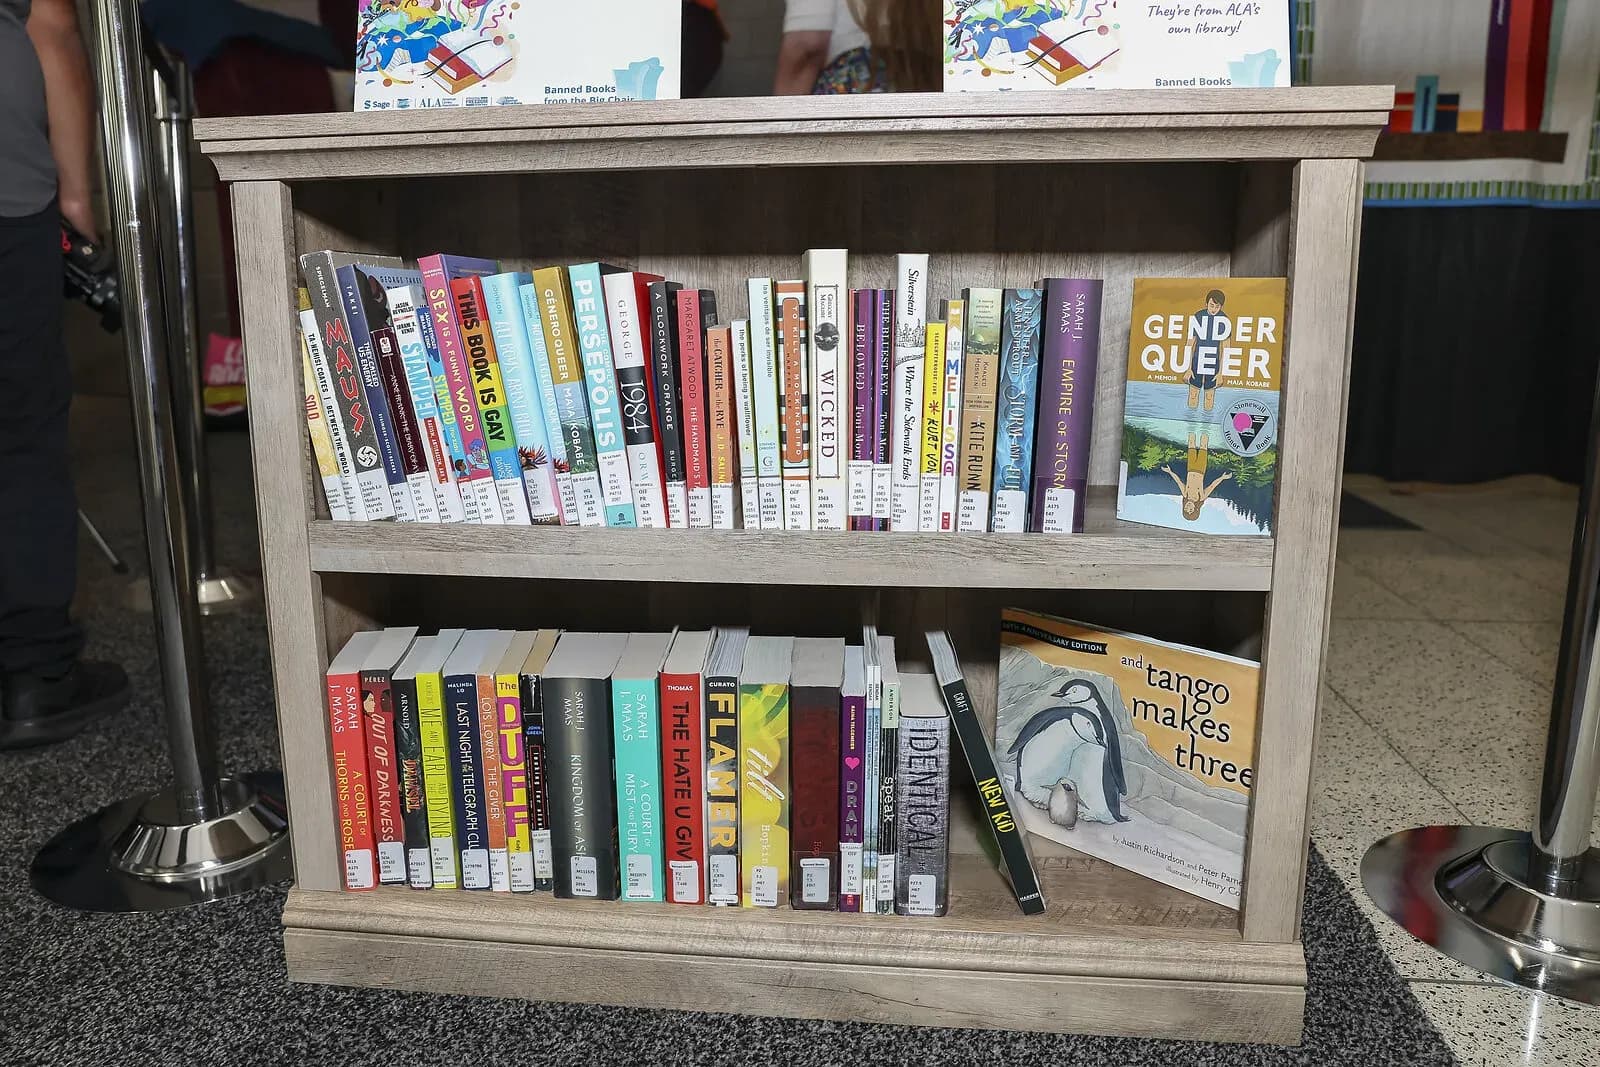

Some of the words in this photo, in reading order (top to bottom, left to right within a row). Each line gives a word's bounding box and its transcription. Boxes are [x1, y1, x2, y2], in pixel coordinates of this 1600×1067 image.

[1148, 3, 1192, 20] They're
[1194, 5, 1223, 17] from
[1226, 3, 1261, 16] ALA's
[1168, 25, 1192, 34] own
[1195, 21, 1241, 36] library!
[544, 85, 583, 94] Banned
[585, 85, 616, 93] Books
[1155, 77, 1197, 87] Banned
[1199, 76, 1232, 86] Books
[372, 100, 390, 109] Sage
[419, 98, 442, 107] ALA
[346, 285, 359, 315] TAKEI
[429, 288, 449, 323] SEX
[655, 292, 662, 300] A
[907, 268, 920, 316] Silverstein
[458, 290, 480, 331] THIS
[684, 296, 695, 352] MARGARET
[881, 300, 891, 324] THE
[1060, 301, 1072, 334] MAAS
[1073, 292, 1086, 331] SARAH
[442, 326, 451, 337] IS
[544, 288, 561, 337] GÉNERO
[553, 339, 569, 380] QUEER
[618, 299, 632, 360] GEORGE
[656, 306, 669, 377] CLOCKWORK
[762, 296, 770, 325] ventajas
[766, 348, 774, 378] invisible
[1010, 299, 1022, 376] ARMENTROUT
[1022, 304, 1032, 357] JENNIFER
[1072, 333, 1082, 342] J.
[1143, 314, 1276, 344] GENDER
[467, 334, 493, 384] BOOK
[574, 279, 617, 447] PERSEPOLIS
[738, 343, 746, 361] perks
[855, 323, 866, 390] BELOVED
[881, 326, 891, 370] BLUEST
[1140, 344, 1272, 379] QUEER
[325, 317, 365, 434] MAUS
[401, 342, 438, 419] STAMPED
[448, 350, 463, 383] FUNNY
[687, 355, 697, 399] ATWOOD
[714, 347, 723, 390] CATCHER
[741, 370, 749, 393] being
[905, 365, 916, 396] Where
[480, 387, 497, 406] IS
[880, 372, 890, 396] EYE
[1058, 359, 1075, 416] EMPIRE
[1246, 380, 1271, 388] KOBABE
[305, 394, 320, 420] SOLD
[455, 386, 475, 432] WORD
[563, 387, 577, 418] MAIA
[620, 379, 651, 434] 1984
[663, 383, 674, 431] ORANGE
[690, 407, 698, 423] THE
[715, 408, 725, 429] RYE
[743, 401, 751, 436] wallflower
[820, 369, 836, 458] WICKED
[855, 404, 865, 430] Toni
[904, 397, 913, 412] the
[943, 359, 960, 477] MELISSA
[1234, 400, 1267, 414] Stonewall
[326, 405, 341, 437] BETWEEN
[484, 409, 506, 442] GAY
[879, 411, 888, 434] Toni
[902, 414, 916, 456] Sidewalk
[927, 417, 939, 451] KURT
[968, 421, 986, 451] KITE
[1056, 421, 1068, 437] OF
[569, 422, 585, 466] KOBABE
[690, 424, 701, 479] HANDMAID'S
[1224, 430, 1241, 450] Honor
[1255, 434, 1271, 450] Book
[902, 455, 912, 481] Ends
[1071, 641, 1103, 652] EDITION
[1120, 655, 1143, 670] and
[499, 682, 518, 690] The
[1147, 663, 1231, 716] tango
[332, 696, 345, 733] MAAS
[345, 686, 359, 729] SARAH
[400, 693, 410, 729] ARNOLD
[420, 708, 442, 727] ME
[455, 702, 470, 728] LAST
[481, 697, 492, 721] LOIS
[564, 698, 574, 726] MAAS
[574, 691, 585, 723] SARAH
[636, 694, 648, 739] SARAH
[952, 692, 970, 714] CRAFT
[1132, 694, 1231, 743] makes
[370, 713, 388, 745] OUT
[574, 725, 585, 733] J.
[622, 703, 633, 742] MAAS
[672, 701, 690, 741] THE
[373, 745, 389, 767] OF
[458, 730, 473, 766] NIGHT
[483, 724, 495, 760] LOWRY
[335, 750, 350, 801] THORNS
[353, 770, 362, 779] A
[423, 747, 446, 779] EARL
[487, 766, 497, 787] THE
[672, 748, 691, 799] HATE
[708, 693, 736, 848] FLAMER
[1175, 733, 1253, 789] three
[401, 759, 421, 814] DAMSEL
[570, 754, 585, 817] KINGDOM
[625, 773, 636, 804] MIST
[640, 778, 650, 788] A
[881, 777, 895, 822] speak
[908, 728, 939, 858] IDENTICAL
[978, 777, 1006, 809] NEW
[353, 783, 368, 826] COURT
[375, 770, 394, 842] DARKNESS
[428, 798, 452, 838] DYING
[462, 773, 478, 831] TELEGRAPH
[489, 789, 500, 820] GIVER
[641, 793, 652, 837] COURT
[674, 806, 691, 819] U
[627, 822, 638, 853] FURY
[1112, 834, 1120, 844] by
[1120, 837, 1142, 852] Justin
[1143, 844, 1185, 867] Richardson
[1186, 862, 1198, 870] and
[1198, 864, 1219, 879] Peter
[1019, 892, 1040, 901] HARPER
[1200, 876, 1227, 895] Henry
